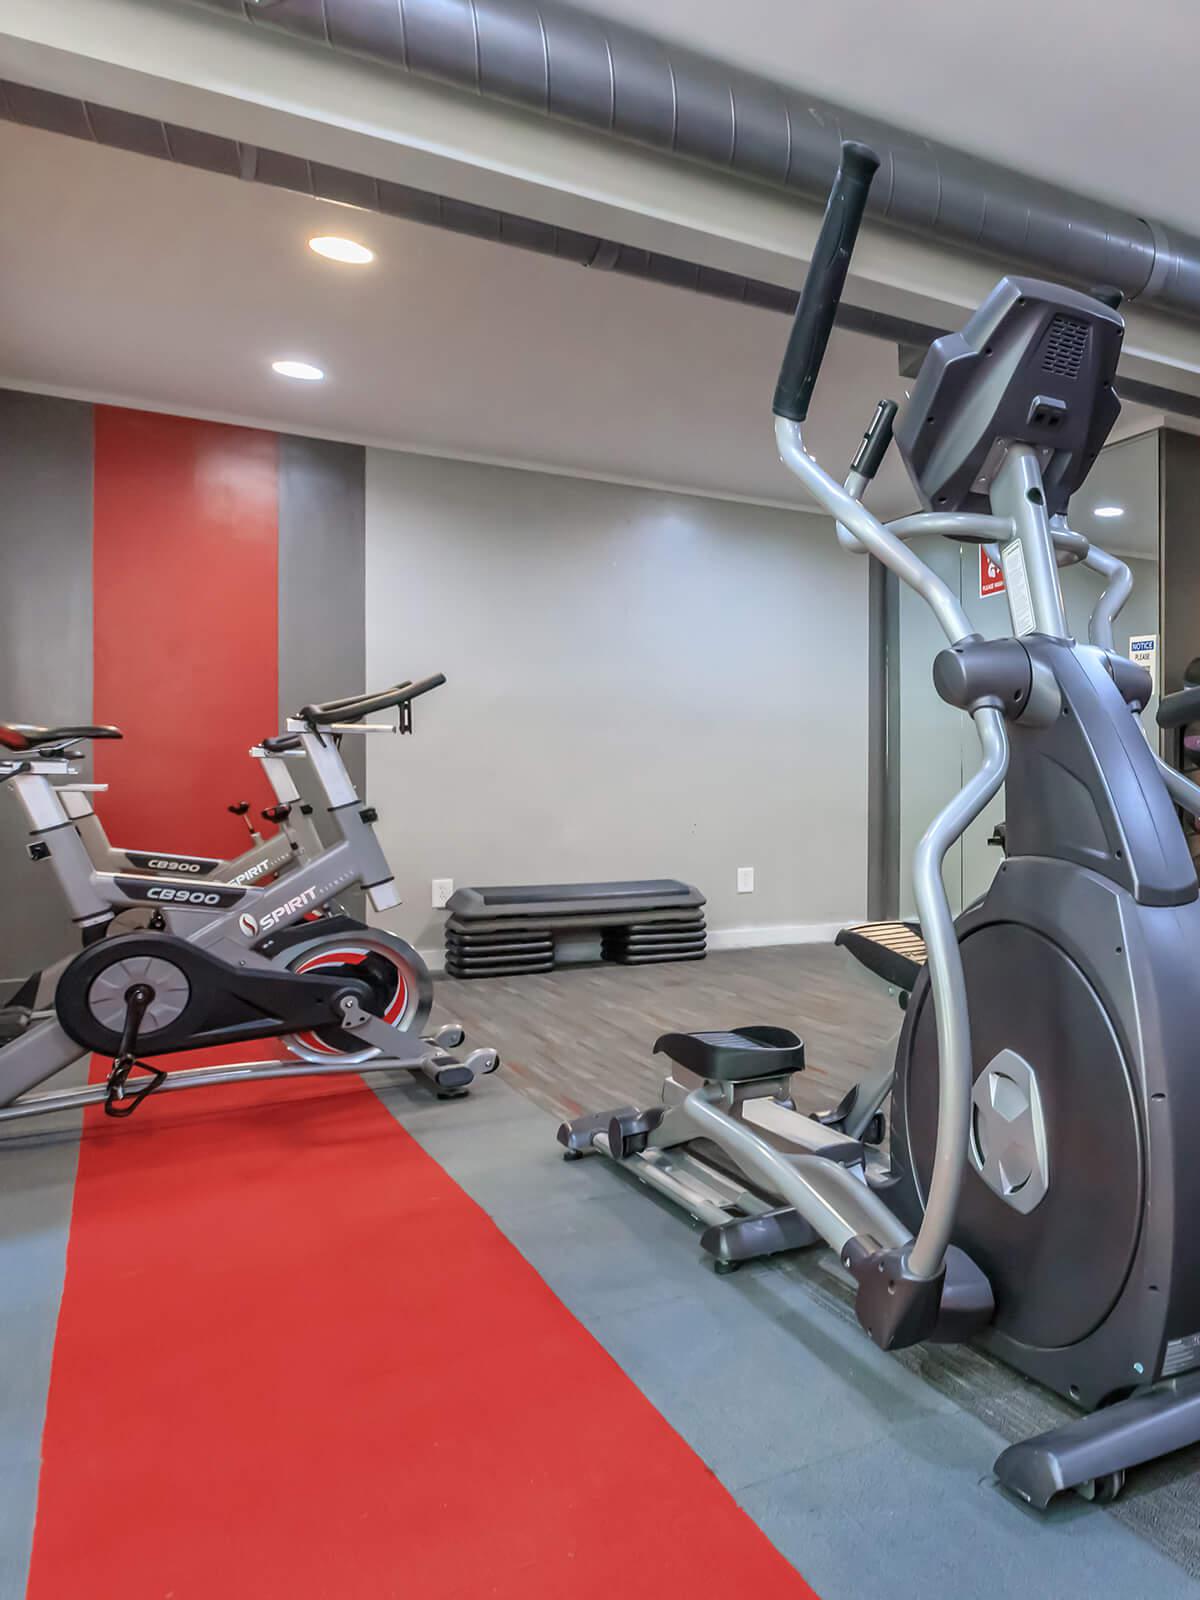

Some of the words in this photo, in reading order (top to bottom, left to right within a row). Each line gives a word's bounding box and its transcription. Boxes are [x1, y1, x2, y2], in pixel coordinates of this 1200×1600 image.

[1132, 641, 1154, 650] NOTICE
[147, 858, 201, 873] CB900
[146, 887, 221, 905] CB900
[259, 886, 317, 931] SPIRIT
